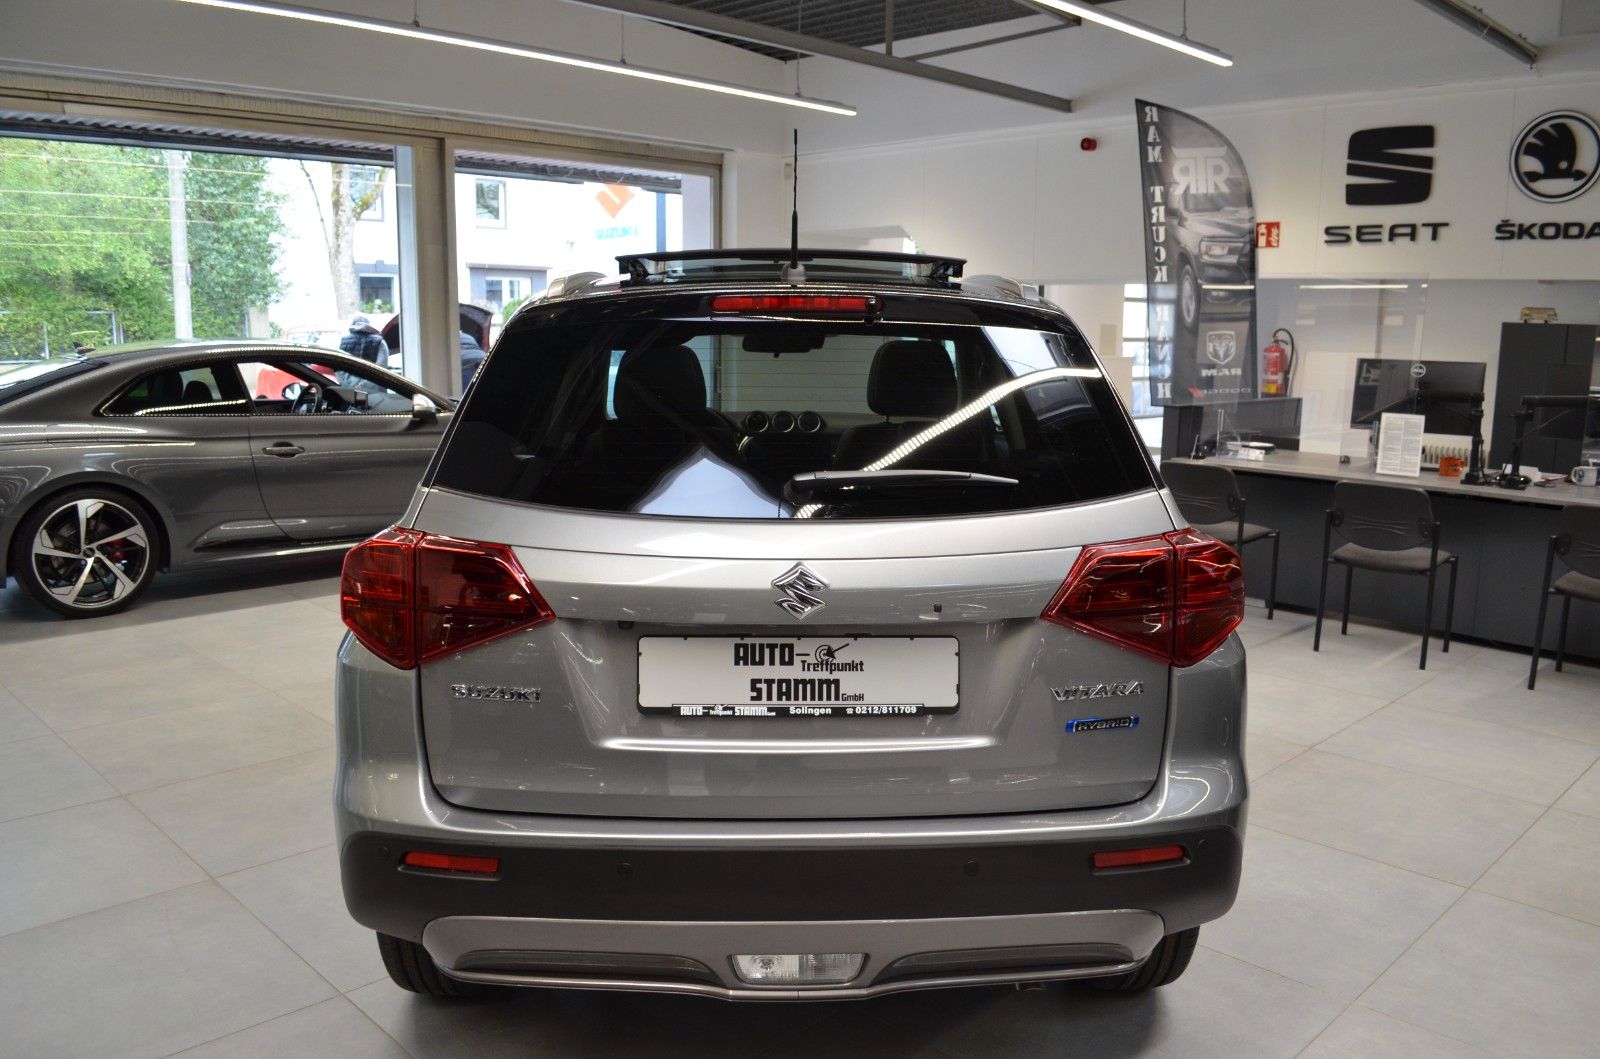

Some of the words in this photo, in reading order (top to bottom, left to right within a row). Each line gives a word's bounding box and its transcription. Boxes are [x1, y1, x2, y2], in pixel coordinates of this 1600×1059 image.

[1323, 222, 1450, 244] SEAT
[801, 660, 865, 674] Treffpunkt
[450, 684, 541, 703] SUZUKI
[841, 693, 865, 702] GmbH
[1050, 681, 1145, 702] VITARA
[788, 706, 832, 716] Solingen
[855, 706, 917, 715] 0212/811709
[1078, 719, 1131, 731] HYBRID
